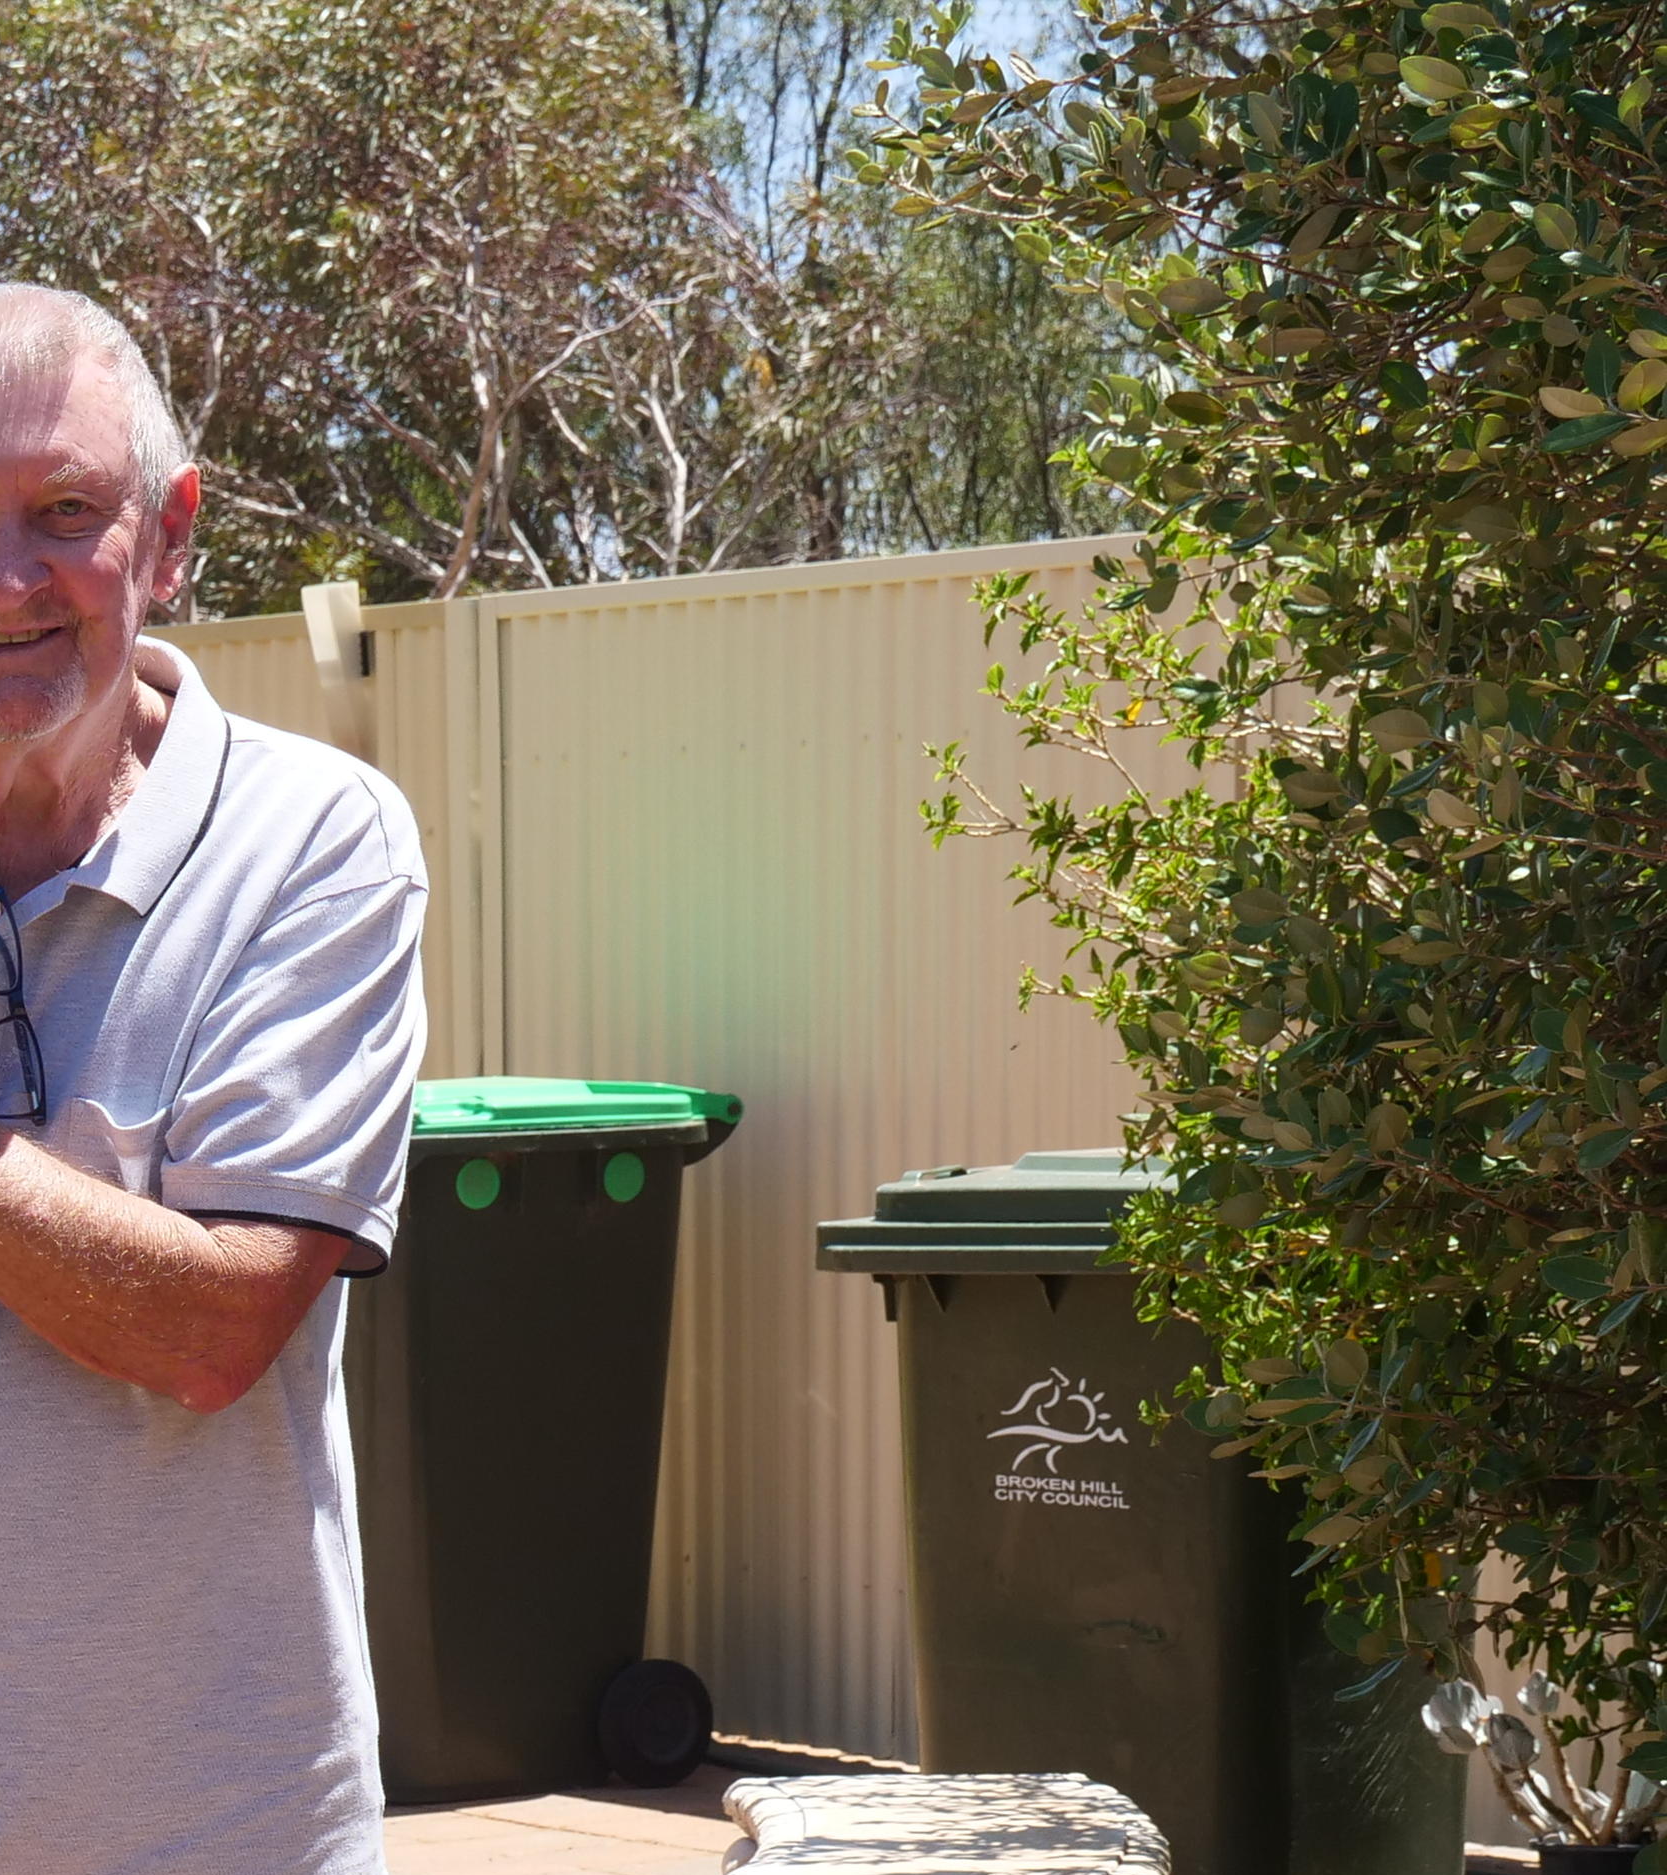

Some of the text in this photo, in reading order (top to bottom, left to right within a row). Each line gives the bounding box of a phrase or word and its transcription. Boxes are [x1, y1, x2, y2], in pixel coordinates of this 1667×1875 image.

[995, 1474, 1124, 1495] BROKEN HILL
[994, 1488, 1131, 1510] CITY COUNCIL
